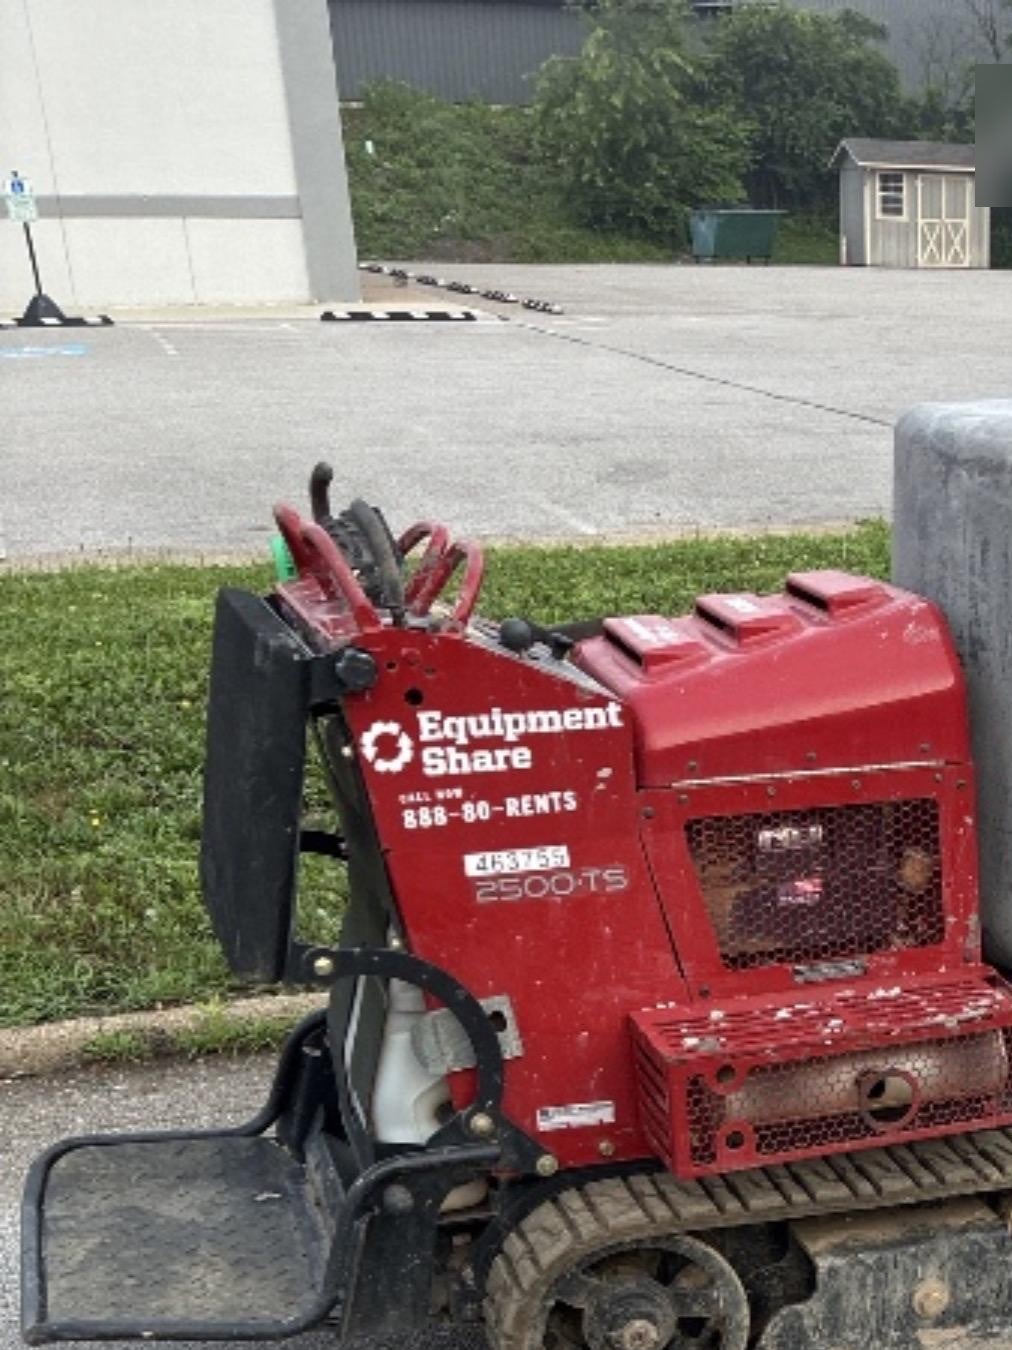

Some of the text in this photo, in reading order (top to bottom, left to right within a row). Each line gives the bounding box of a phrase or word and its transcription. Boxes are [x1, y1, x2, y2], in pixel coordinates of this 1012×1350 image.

[416, 701, 625, 744] Equipment
[421, 746, 533, 777] Share
[402, 790, 578, 829] 888-80-RENTS
